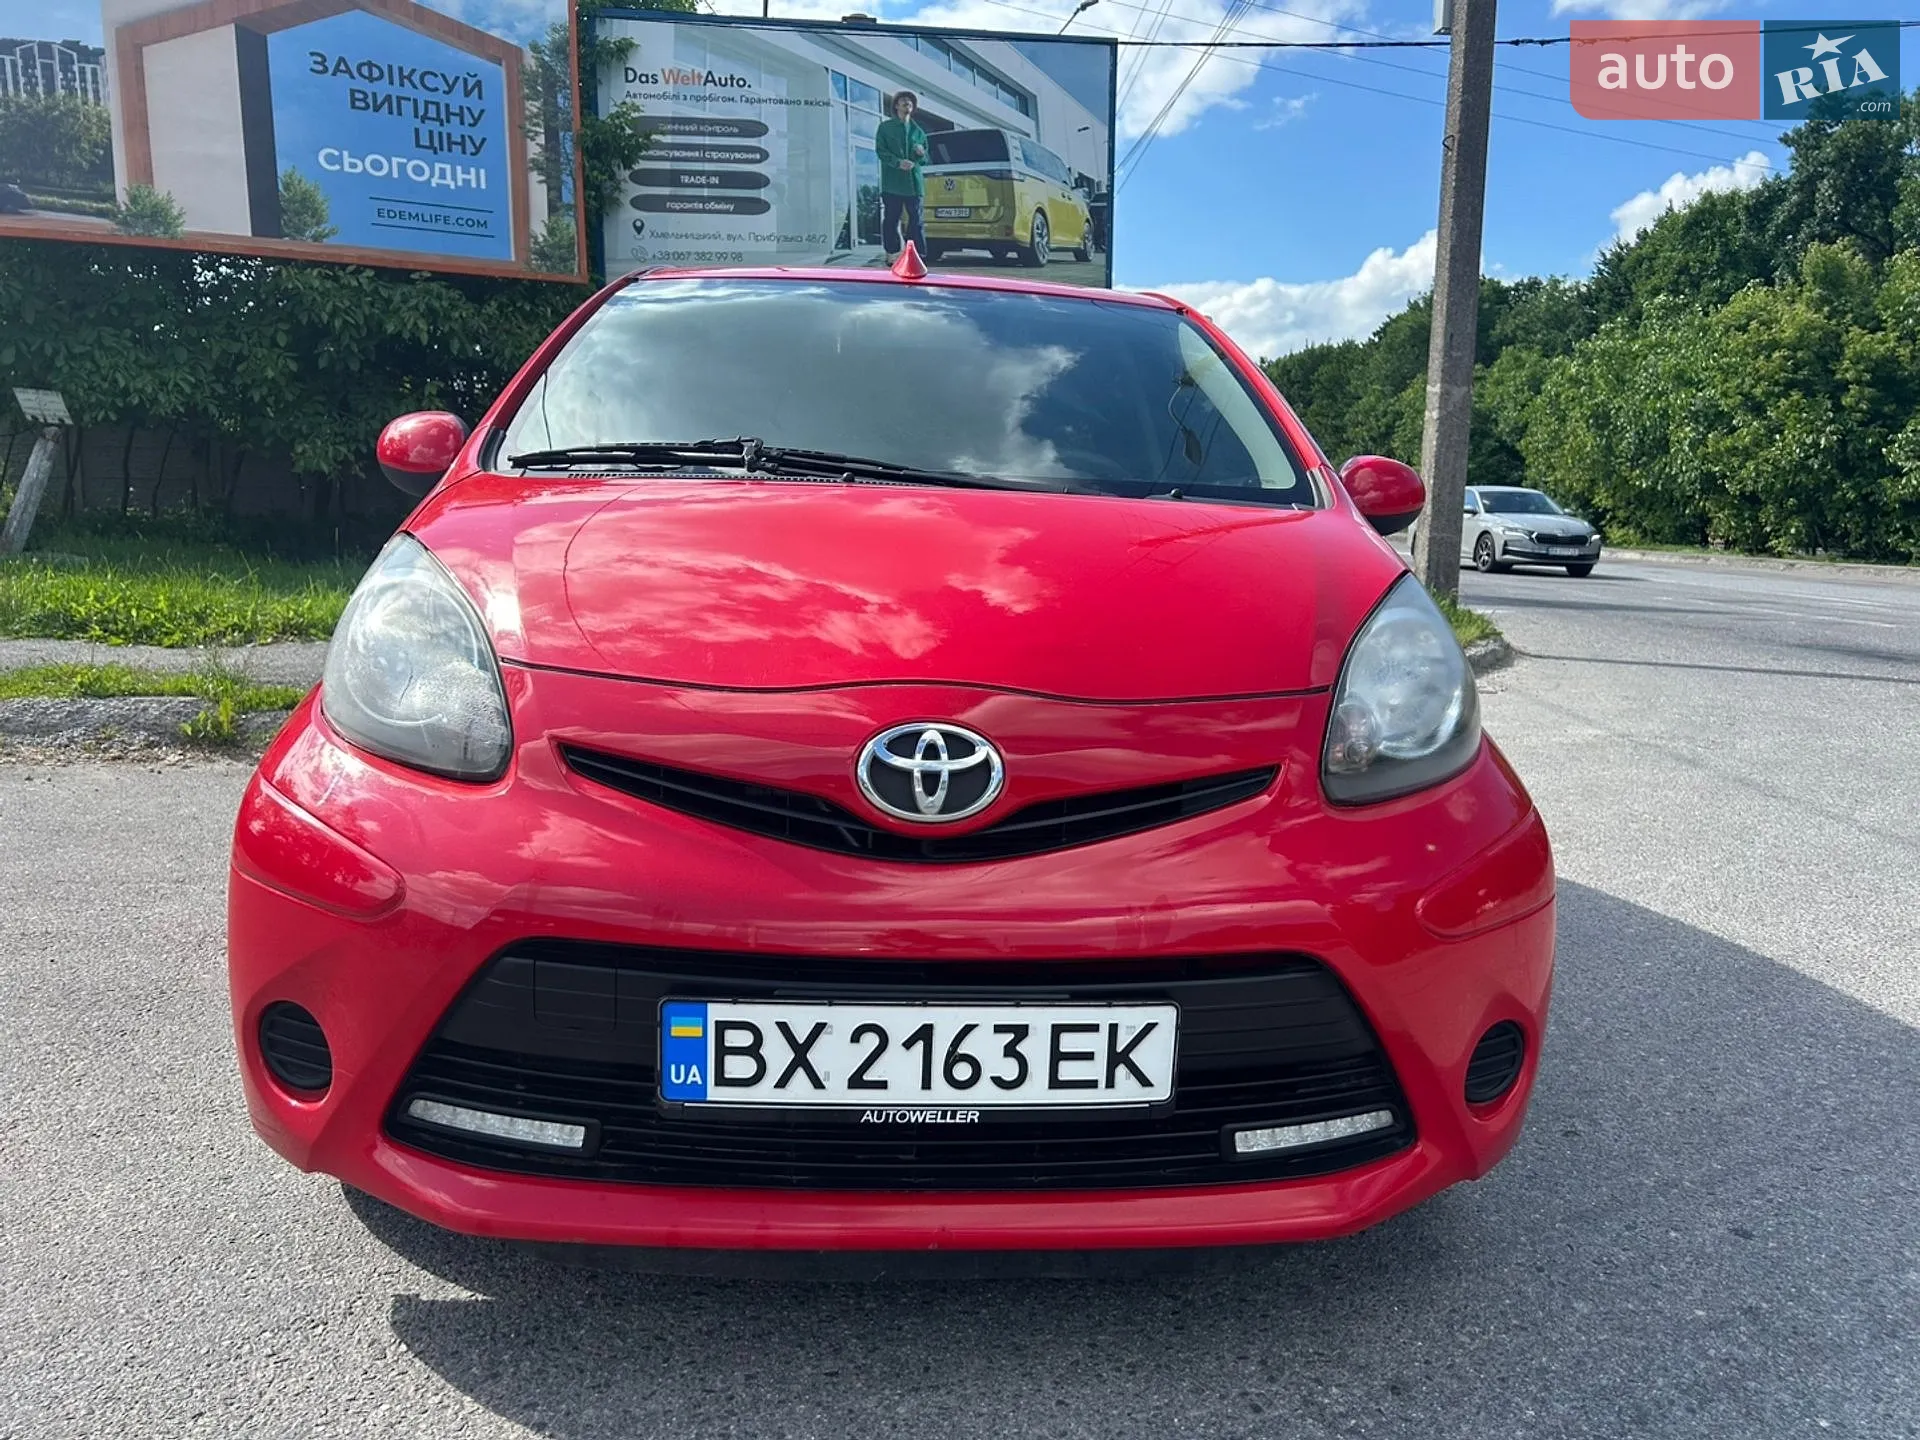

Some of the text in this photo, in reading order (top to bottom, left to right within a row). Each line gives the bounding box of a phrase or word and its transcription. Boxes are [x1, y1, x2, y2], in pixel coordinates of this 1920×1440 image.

[309, 51, 483, 100] ЗАФІКСУЙ
[349, 88, 485, 127] ВИГІДНУ
[625, 90, 680, 101] Автомобілі
[414, 127, 487, 156] ЦІНУ
[318, 148, 487, 189] СЬОГОДНІ
[680, 174, 719, 184] TRADE-IN
[377, 207, 488, 229] EDEMLIFE.COM
[713, 1020, 1160, 1091] BX 2163 EK
[670, 1064, 702, 1085] UA
[860, 1109, 980, 1124] AUTOWELLER
